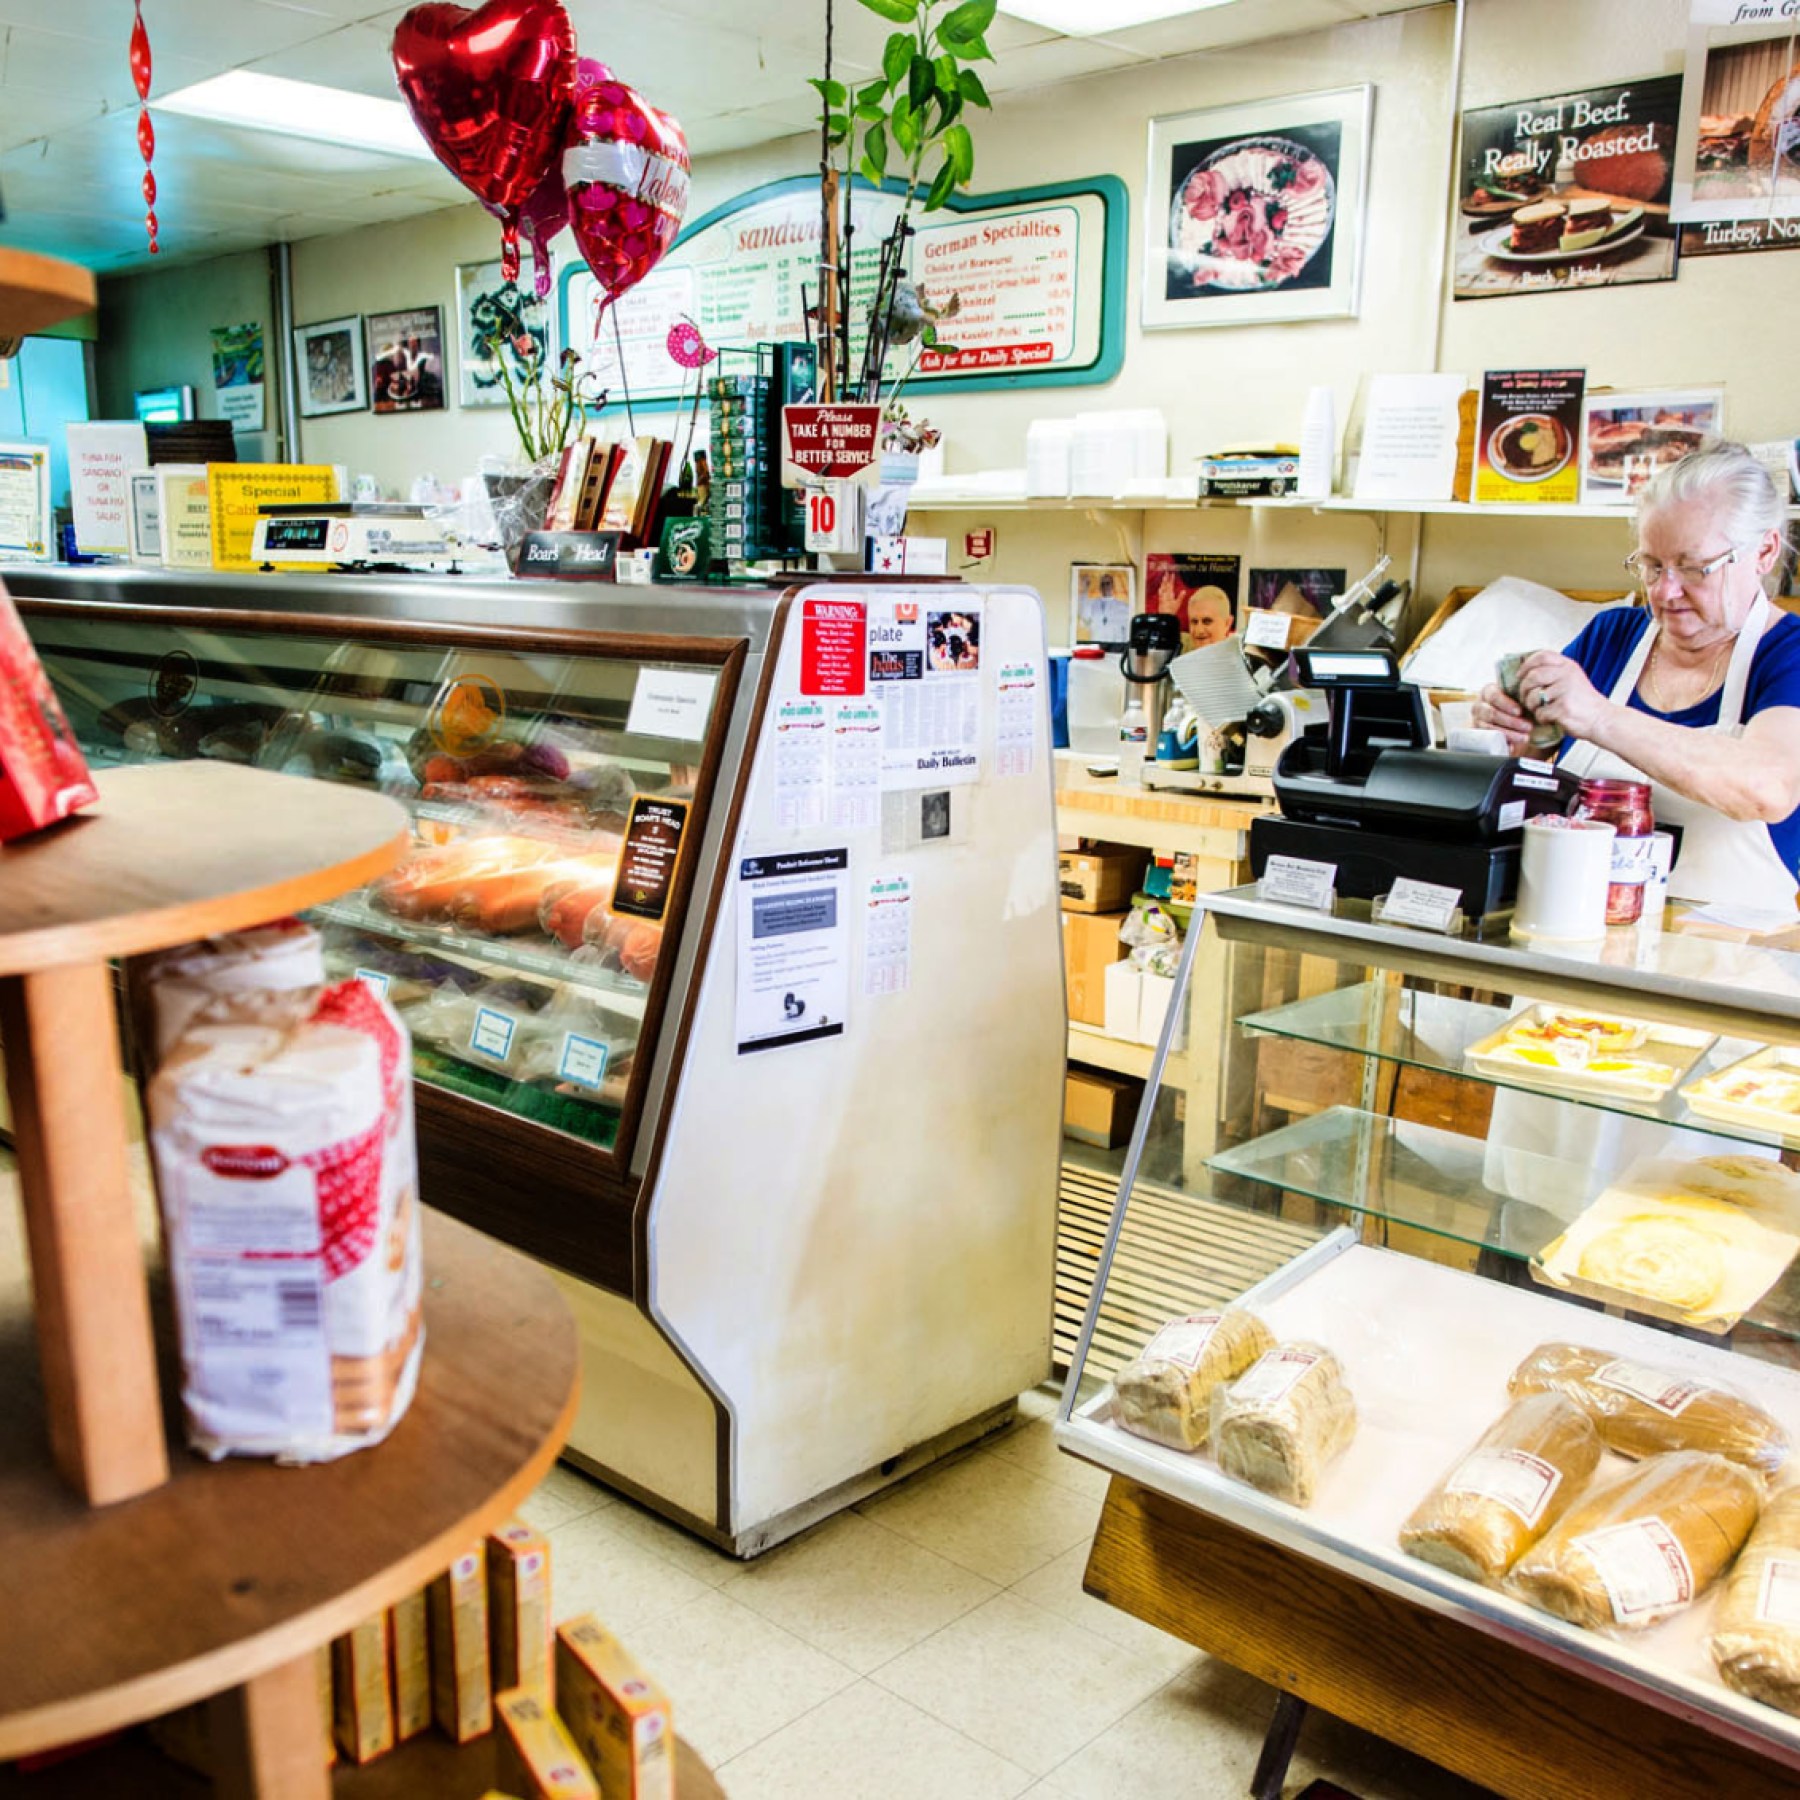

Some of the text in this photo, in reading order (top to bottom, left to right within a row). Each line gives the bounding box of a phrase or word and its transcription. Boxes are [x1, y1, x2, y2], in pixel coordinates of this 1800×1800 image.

[1731, 4, 1773, 24] from
[1515, 91, 1630, 138] Real Beef.
[1483, 121, 1660, 175] Really Roasted.
[924, 220, 1062, 258] German Specialties
[1701, 218, 1761, 247] Turkey,
[924, 262, 955, 275] Choice
[958, 260, 968, 270] of
[969, 255, 1013, 269] Bratwurst
[923, 345, 1051, 372] Ask for the Daily Special
[816, 409, 853, 422] Please
[791, 424, 872, 438] TAKE A NUMBER
[825, 439, 846, 449] FOR
[795, 450, 871, 464] BETTER SERVICE
[82, 468, 124, 478] SANDWIC
[241, 485, 301, 499] Special
[810, 495, 836, 534] 10
[574, 542, 609, 562] Head
[869, 625, 903, 646] plate
[873, 655, 904, 673] haus
[879, 652, 898, 661] The
[917, 754, 977, 772] Daily Bulletin
